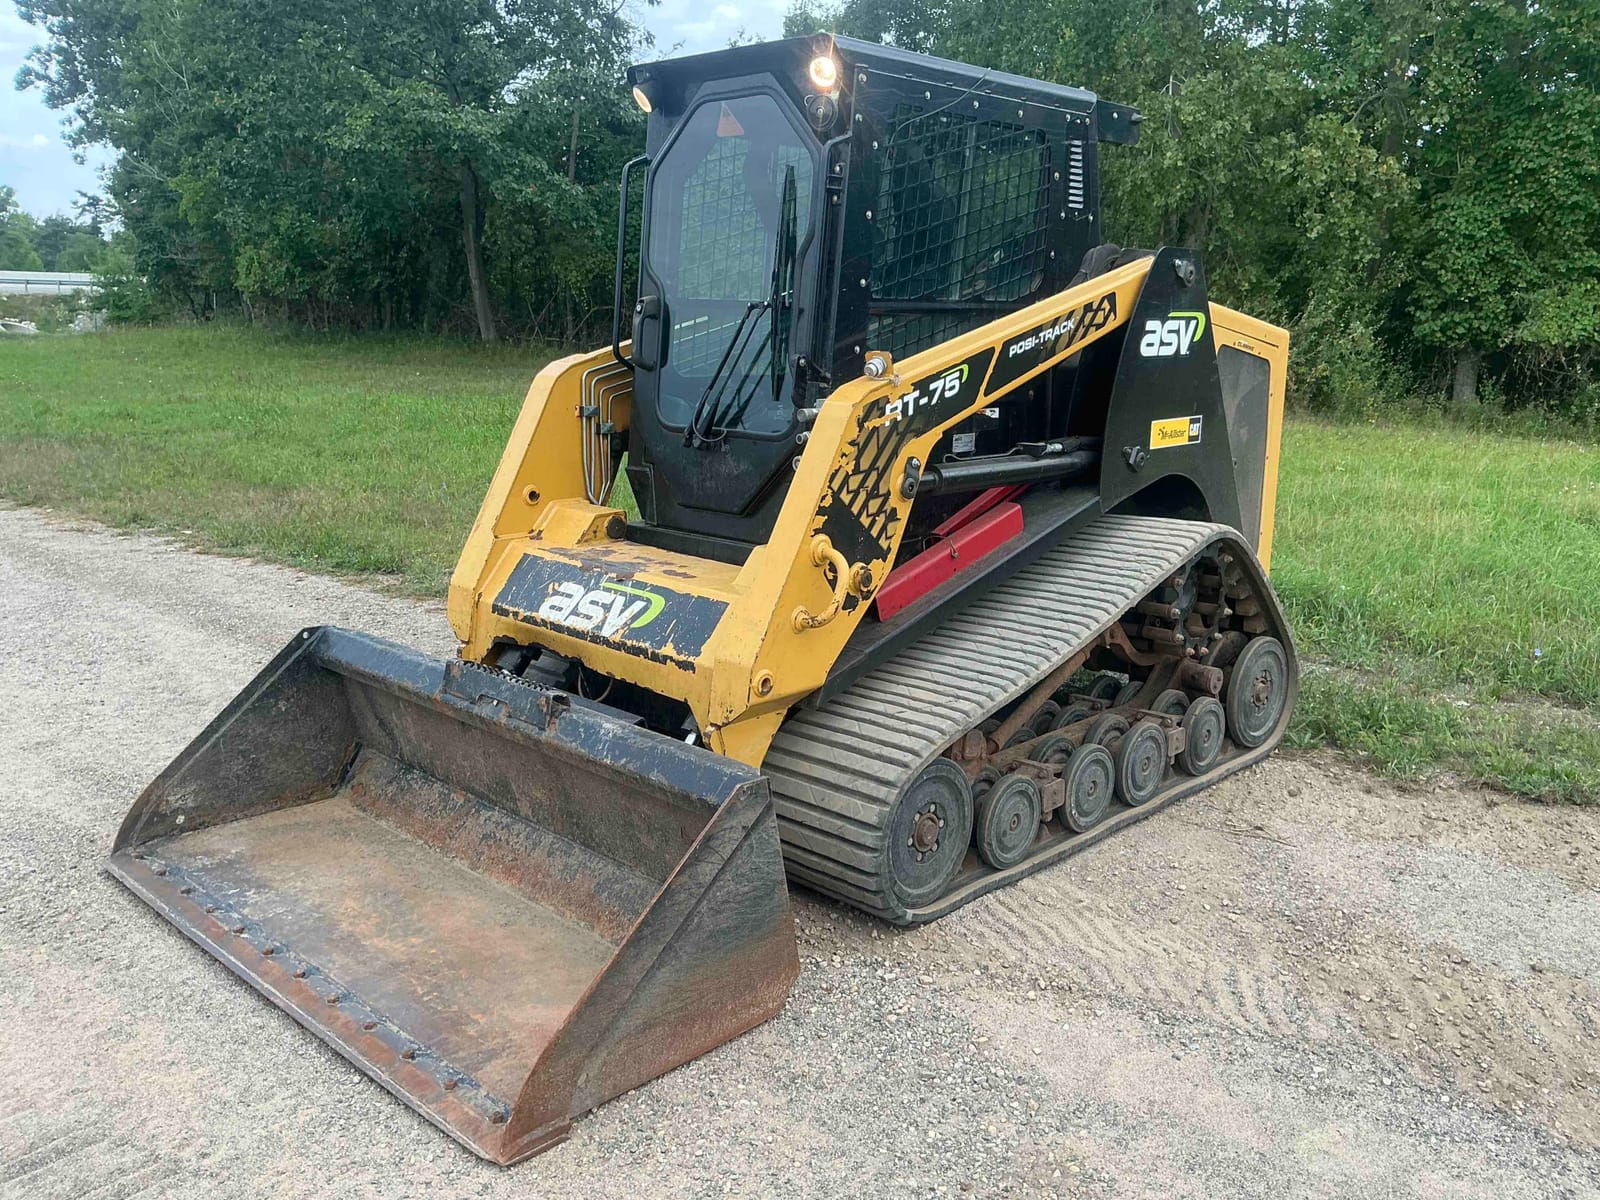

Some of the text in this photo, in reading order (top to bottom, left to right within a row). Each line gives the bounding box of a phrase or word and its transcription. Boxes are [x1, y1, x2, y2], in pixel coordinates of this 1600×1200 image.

[1009, 318, 1075, 358] POSI-TRACK
[1140, 320, 1198, 356] asv
[885, 371, 960, 427] RT-75
[538, 582, 648, 638] asv
